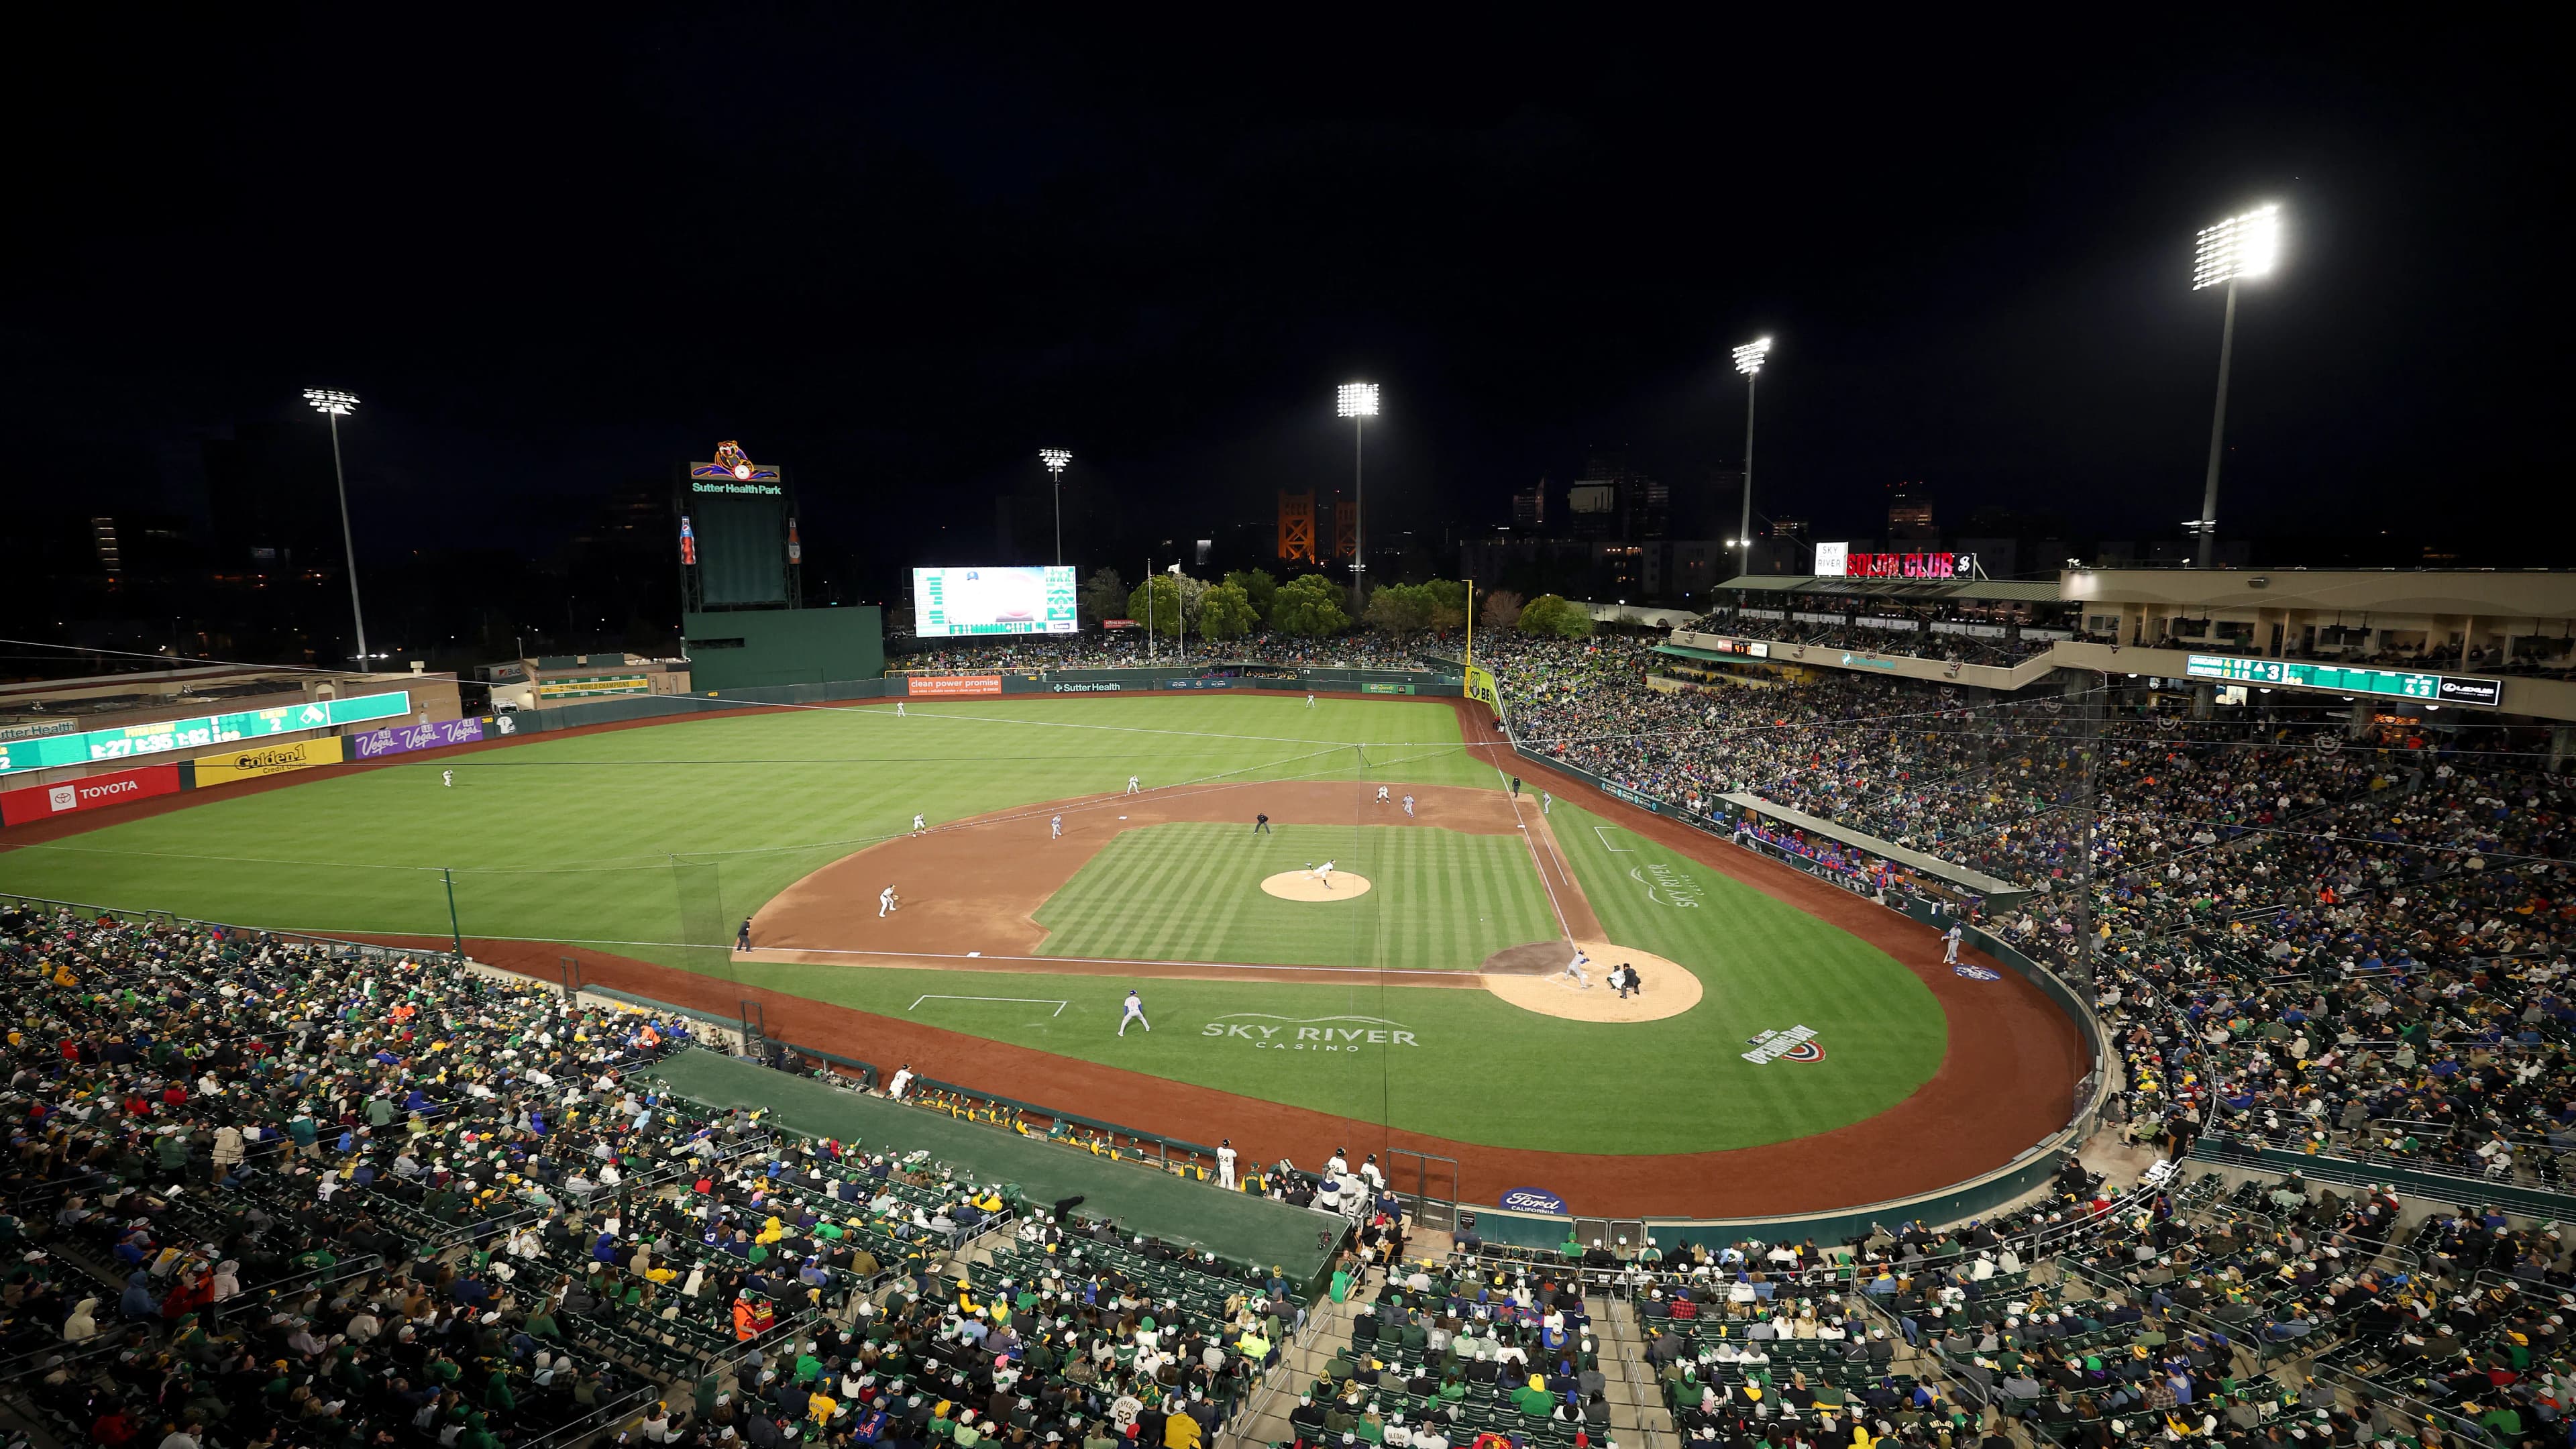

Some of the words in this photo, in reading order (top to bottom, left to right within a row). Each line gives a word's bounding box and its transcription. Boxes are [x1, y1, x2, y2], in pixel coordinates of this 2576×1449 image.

[692, 482, 724, 493] Sutter
[725, 484, 758, 494] Health
[759, 485, 782, 495] Park
[1823, 545, 1838, 555] SKY
[1817, 559, 1841, 568] RIVER
[1847, 553, 1900, 577] SOLON
[1904, 553, 1953, 578] CLUB
[2190, 657, 2223, 666] CHICAGO
[2224, 659, 2232, 667] 4
[2189, 665, 2222, 676] ATHLETICS
[2235, 669, 2240, 678] 1
[2267, 665, 2280, 680] 3
[936, 680, 963, 688] power
[965, 678, 999, 688] promise
[1063, 684, 1091, 692] Sutter
[1092, 683, 1120, 691] Health
[2405, 684, 2415, 694] 4
[2420, 686, 2430, 696] 3
[2456, 686, 2494, 694] LEXUS
[32, 722, 74, 735] Health
[270, 718, 282, 731] 2
[400, 729, 440, 749] Vegas
[441, 722, 482, 743] Vegas
[356, 733, 398, 756] Vegas
[263, 763, 285, 773] Credit
[80, 780, 138, 800] TOYOTA
[1648, 864, 1682, 888] RIVER
[1665, 889, 1699, 908] SKY
[1201, 1023, 1282, 1039] SKY
[1297, 1026, 1419, 1046] RIVER
[1255, 1041, 1358, 1052] CASINO
[1741, 1036, 1802, 1064] OPENING
[1780, 1024, 1819, 1042] DAY
[1506, 1192, 1560, 1210] Ford
[1511, 1205, 1555, 1215] CALIFORNIA
[1115, 1400, 1138, 1415] CESPEDES
[1118, 1410, 1132, 1425] 52
[859, 1422, 875, 1438] 44
